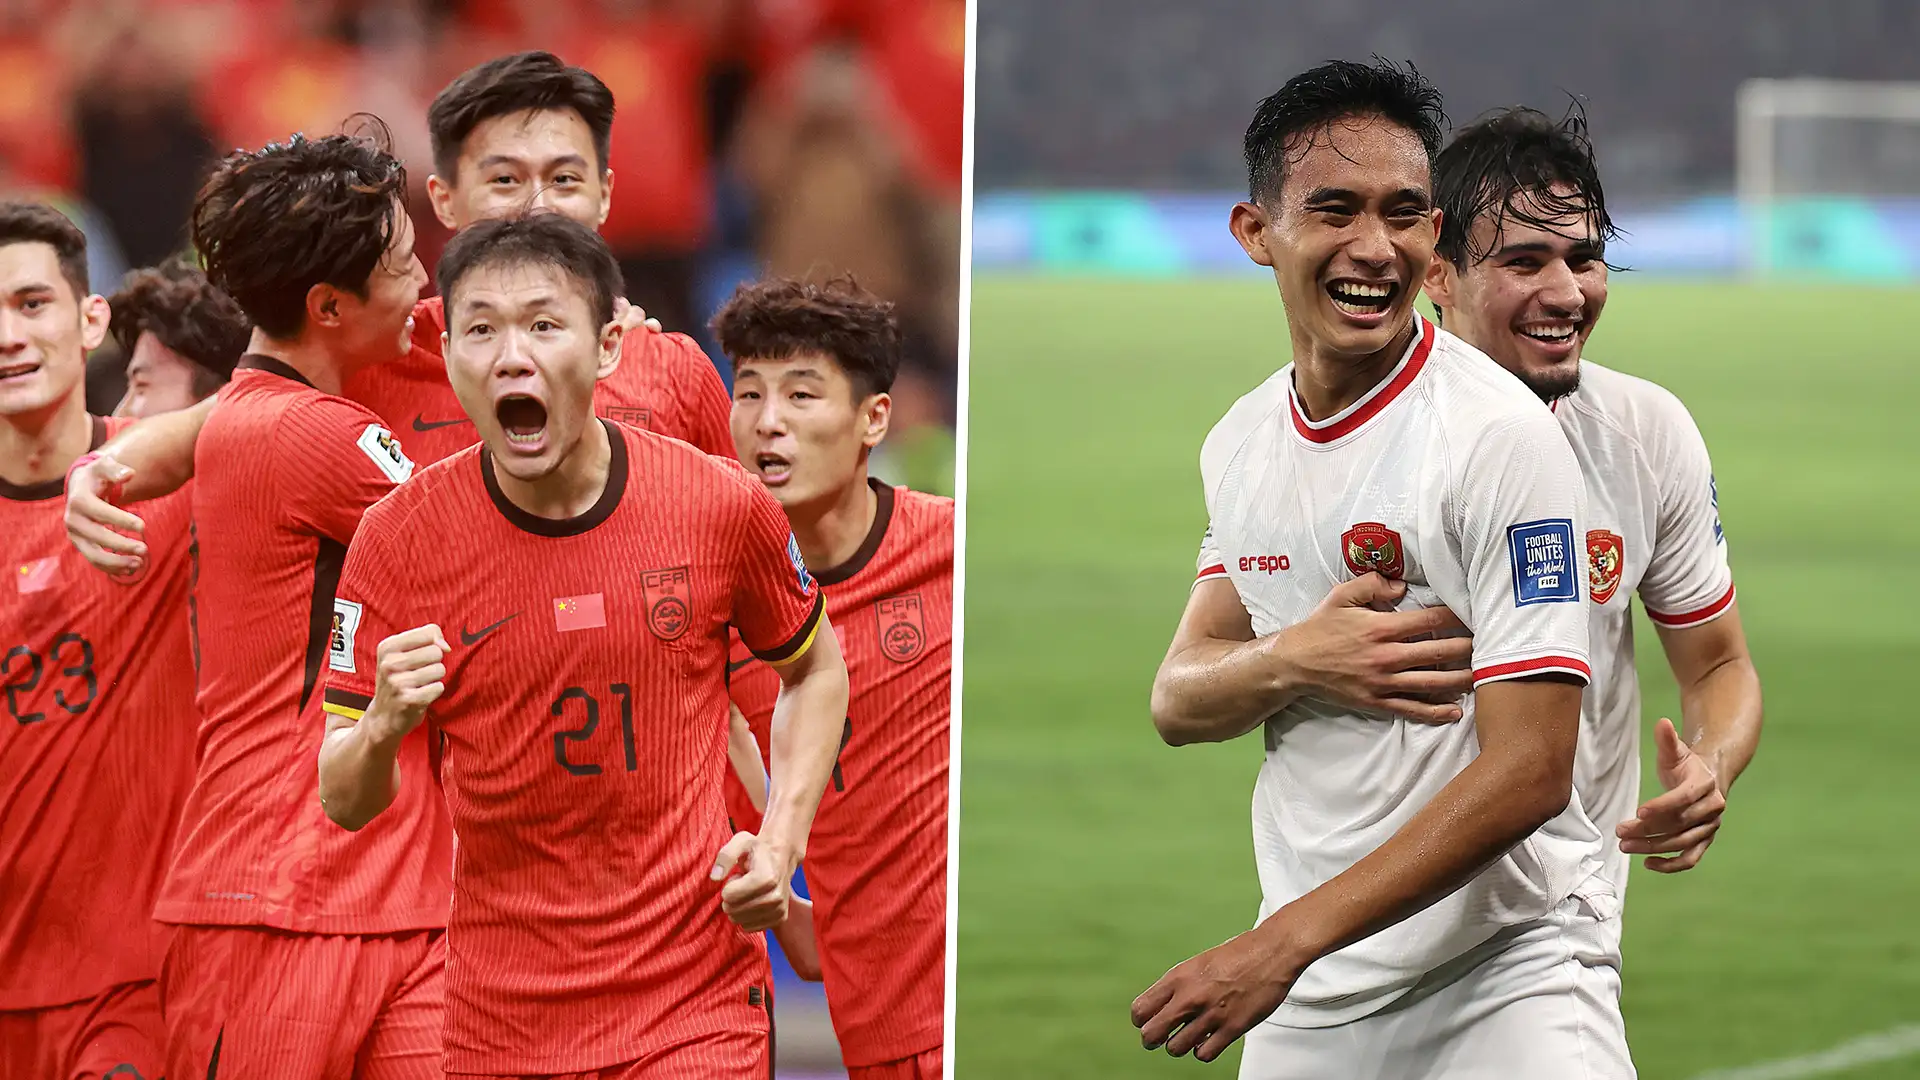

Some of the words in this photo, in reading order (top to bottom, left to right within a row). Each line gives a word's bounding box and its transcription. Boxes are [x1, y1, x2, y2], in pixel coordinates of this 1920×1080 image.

[1525, 533, 1563, 548] FOOTBALL
[1526, 544, 1564, 563] UNITES
[1239, 555, 1290, 575] erspo
[1525, 563, 1542, 577] the
[1543, 560, 1565, 575] World
[646, 572, 685, 588] CFA
[1541, 577, 1557, 586] FIFA
[880, 598, 918, 615] CFA
[1, 633, 97, 725] 23
[551, 682, 637, 776] 21
